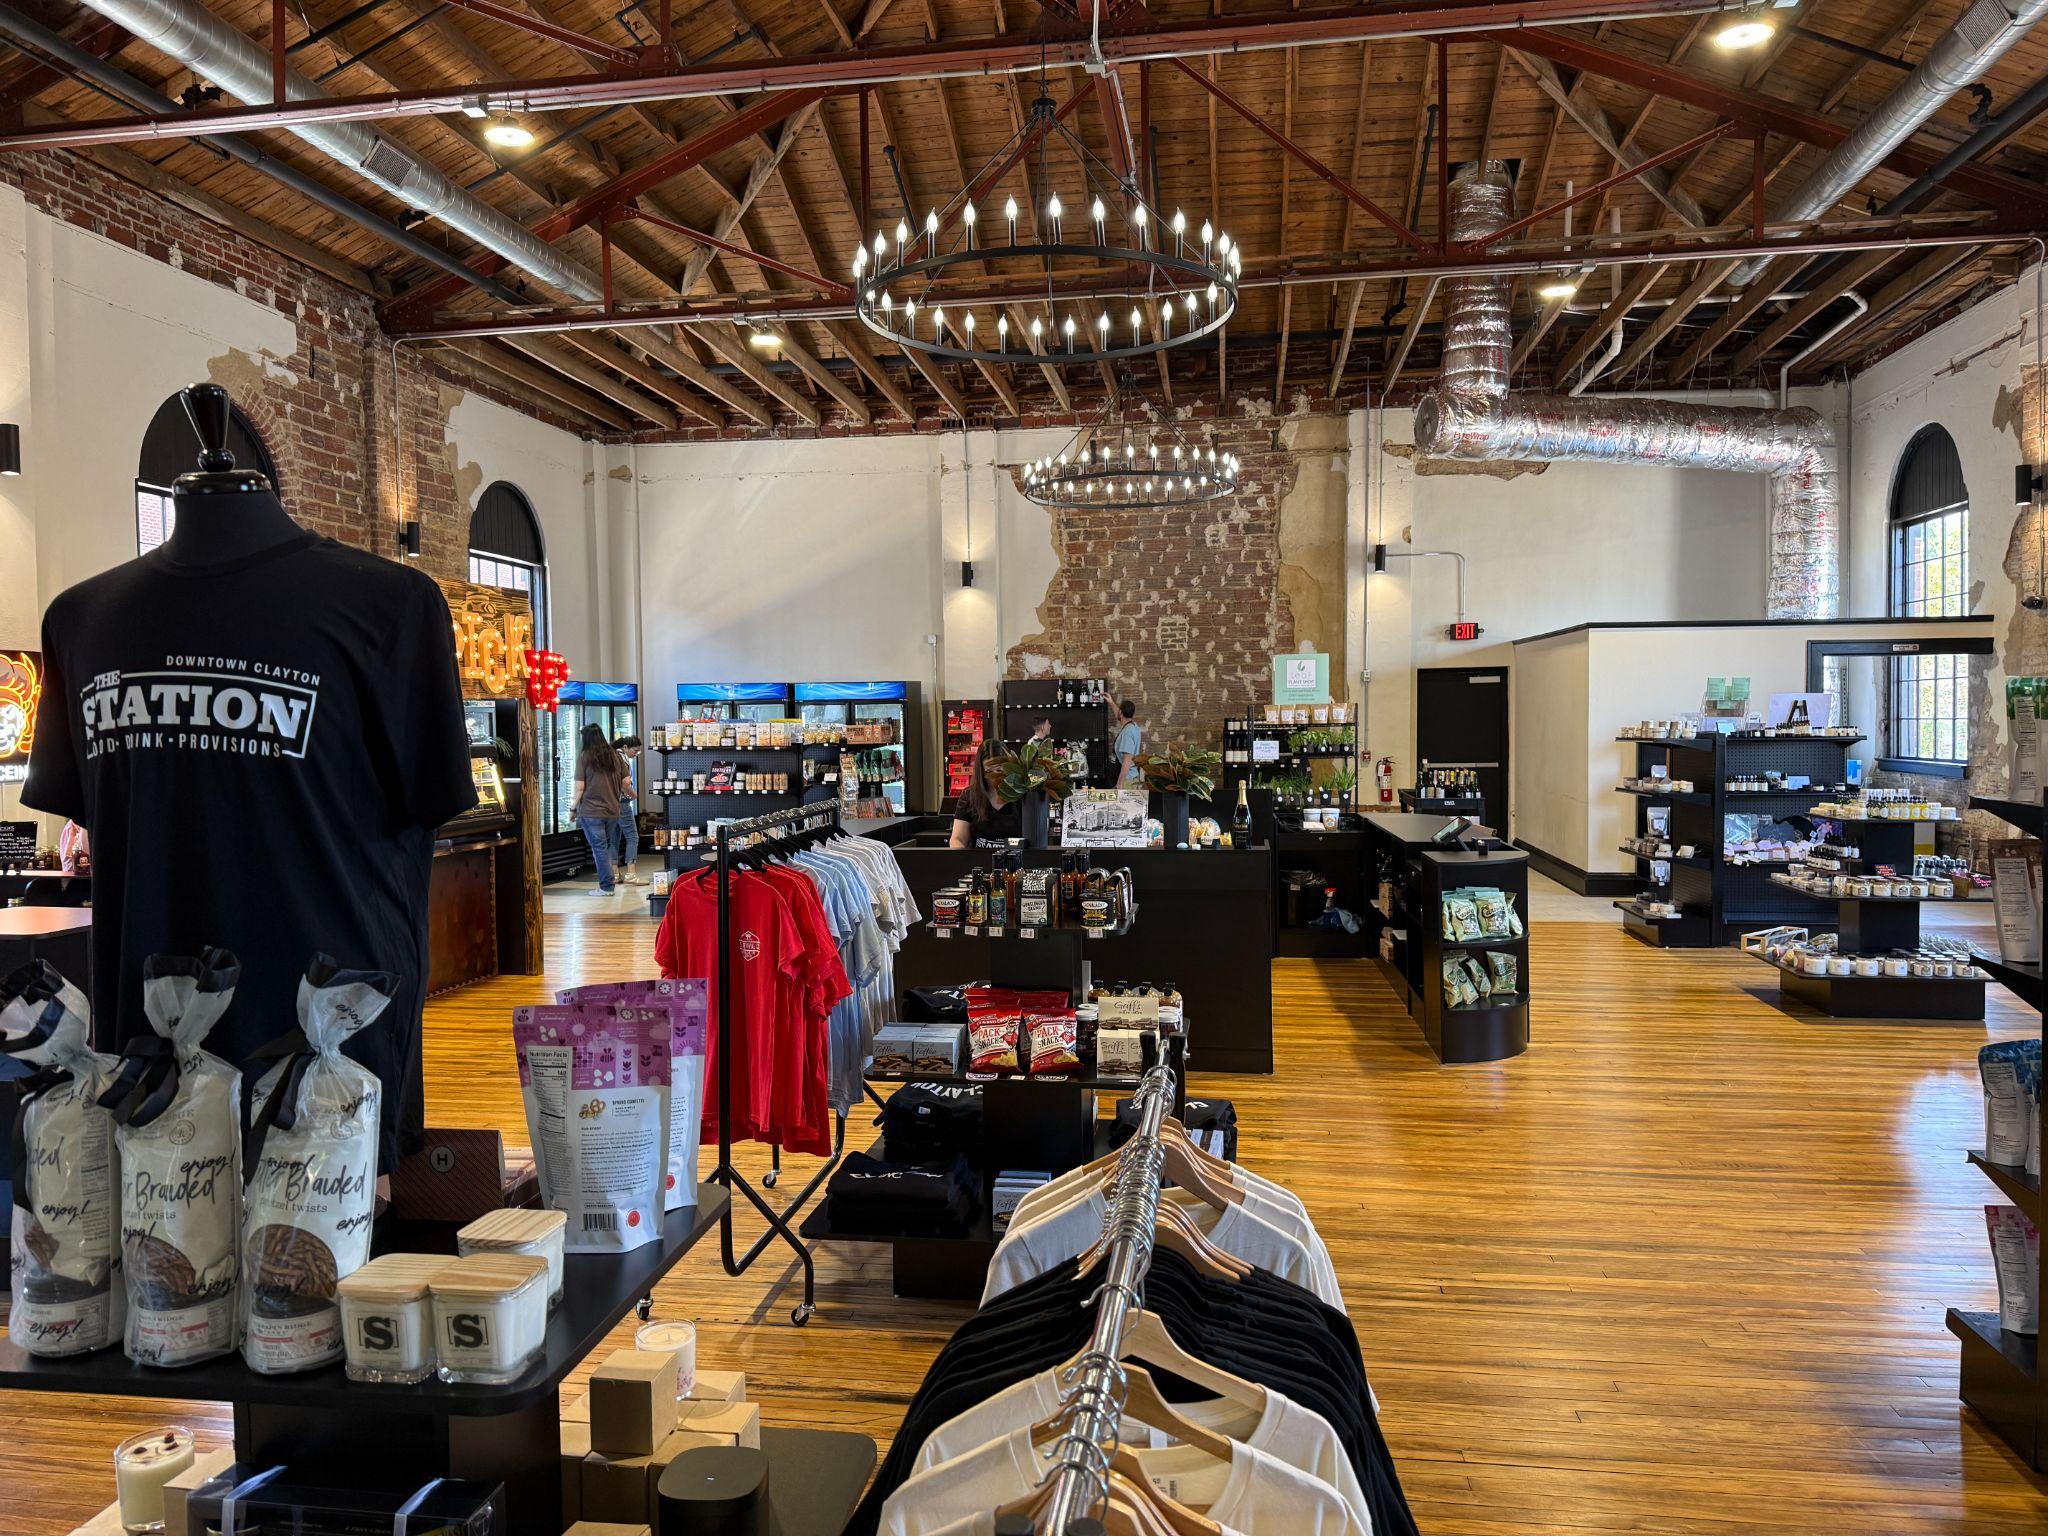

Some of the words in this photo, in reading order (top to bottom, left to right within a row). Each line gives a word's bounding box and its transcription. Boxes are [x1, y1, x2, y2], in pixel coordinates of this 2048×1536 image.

[1455, 623, 1475, 639] EXIT
[94, 669, 121, 690] THE
[166, 655, 247, 671] DOWNTOWN
[254, 662, 321, 686] CLAYTON
[524, 649, 569, 713] UP
[82, 684, 308, 741] STATION
[178, 733, 281, 758] PROVISIONS
[1113, 999, 1142, 1012] Griff's
[978, 1027, 1000, 1040] PACK
[180, 1149, 236, 1178] enjoy!
[437, 1152, 449, 1166] H
[135, 1165, 216, 1211] Braided
[285, 1161, 368, 1204] Braided
[41, 1200, 91, 1224] enjoy!
[291, 1201, 328, 1214] twists
[29, 1318, 85, 1343] enjoy!
